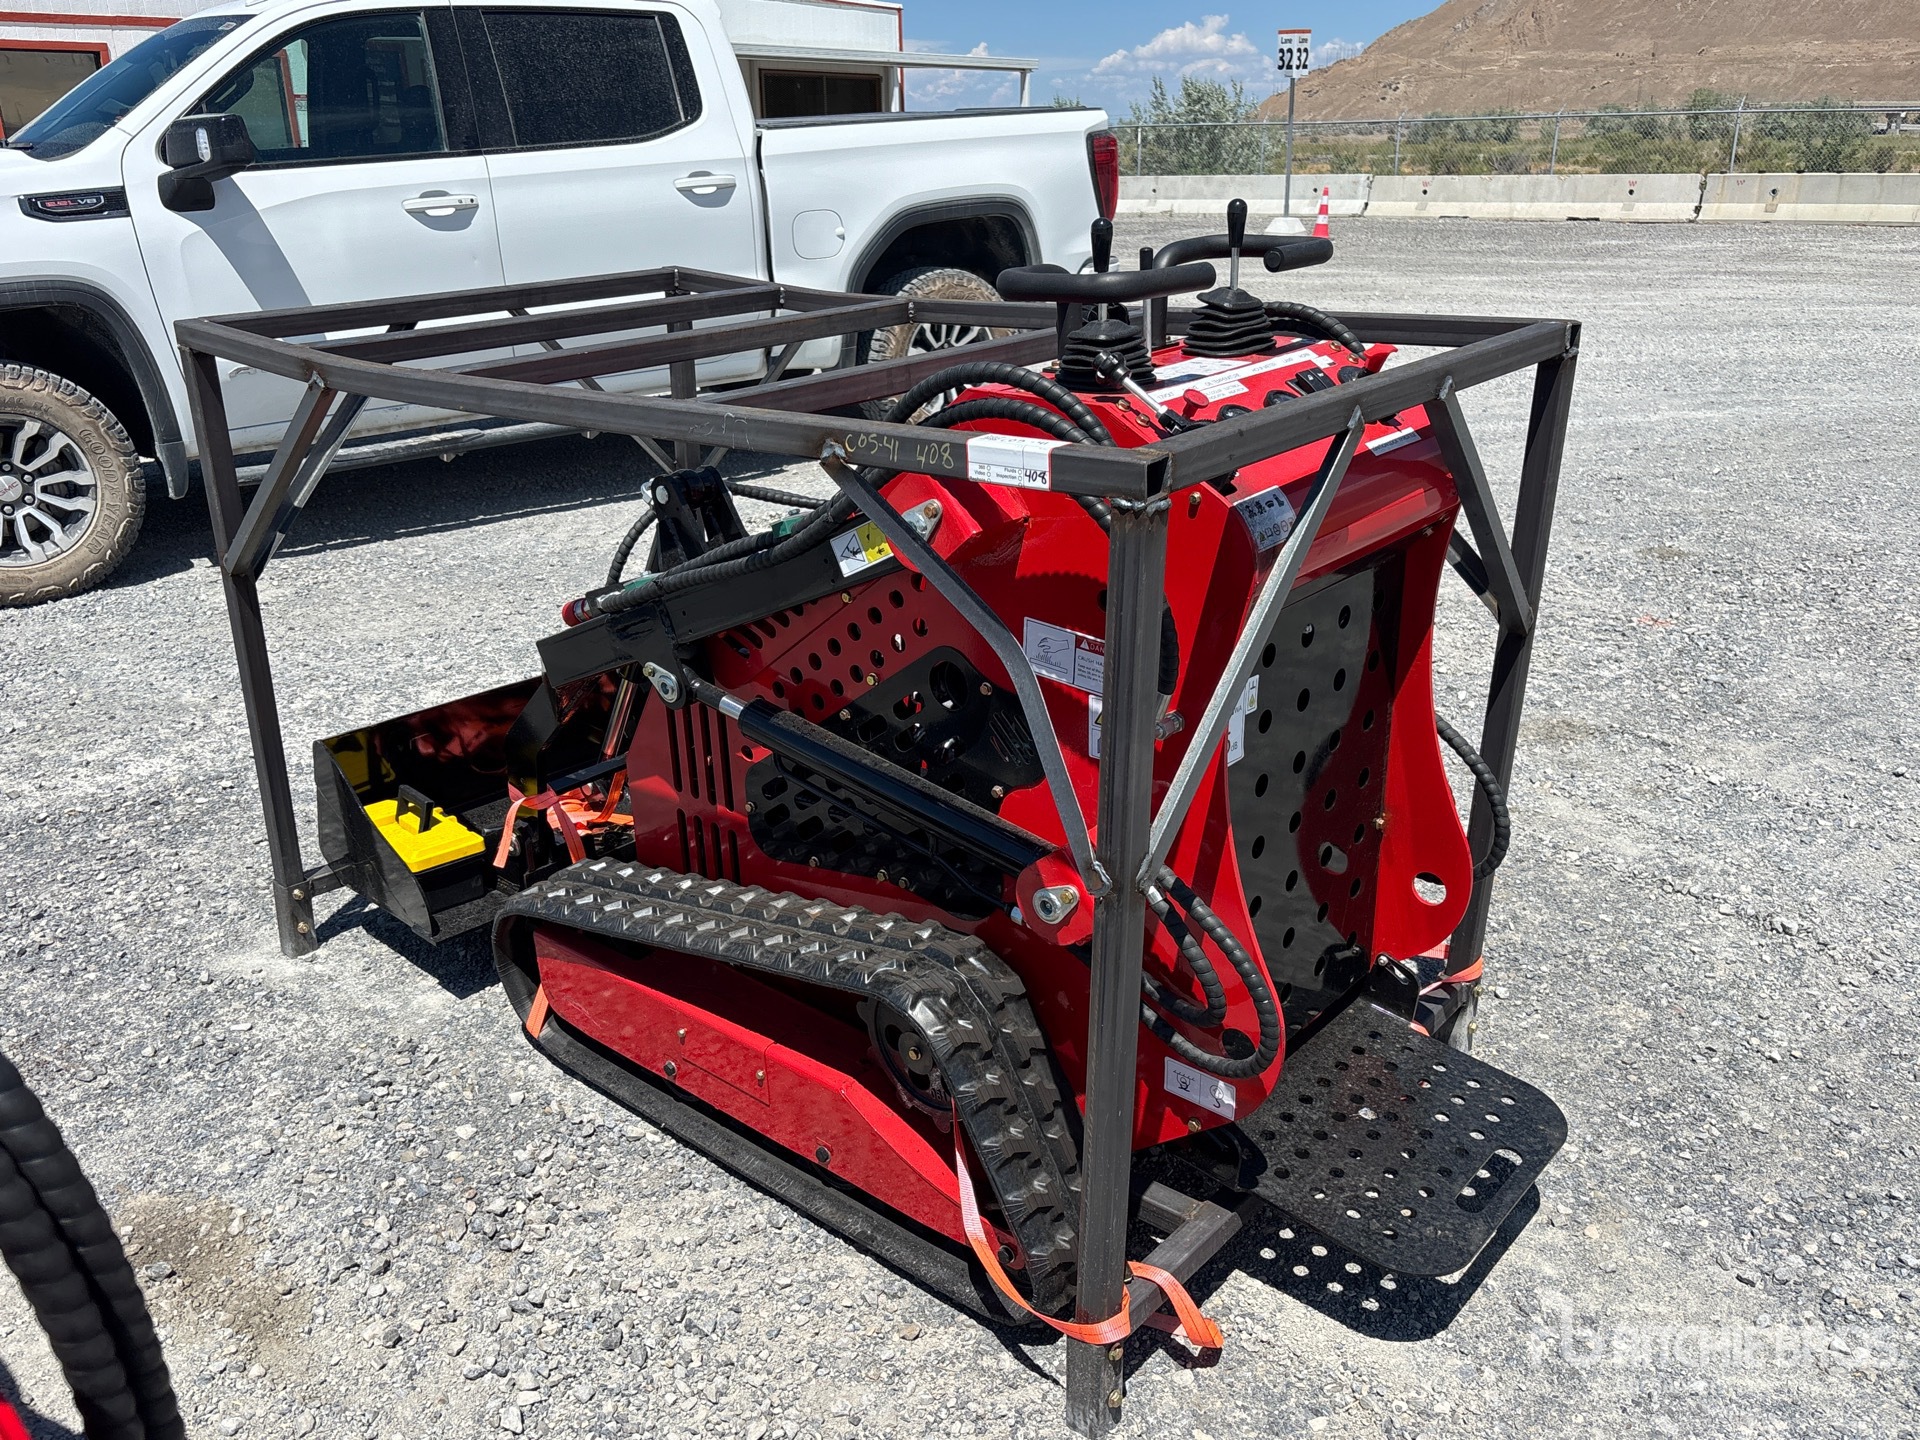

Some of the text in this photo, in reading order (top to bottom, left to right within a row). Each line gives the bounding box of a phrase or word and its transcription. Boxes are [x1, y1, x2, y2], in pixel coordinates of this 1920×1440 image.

[1280, 36, 1293, 44] Lane
[1298, 36, 1309, 44] Lane
[1277, 47, 1294, 70] 32
[1295, 47, 1309, 70] 32
[916, 442, 954, 469] 408
[996, 472, 1017, 480] Inspection
[1024, 469, 1047, 484] 408
[79, 429, 123, 554] GOODYEAR
[1090, 643, 1104, 653] DAN
